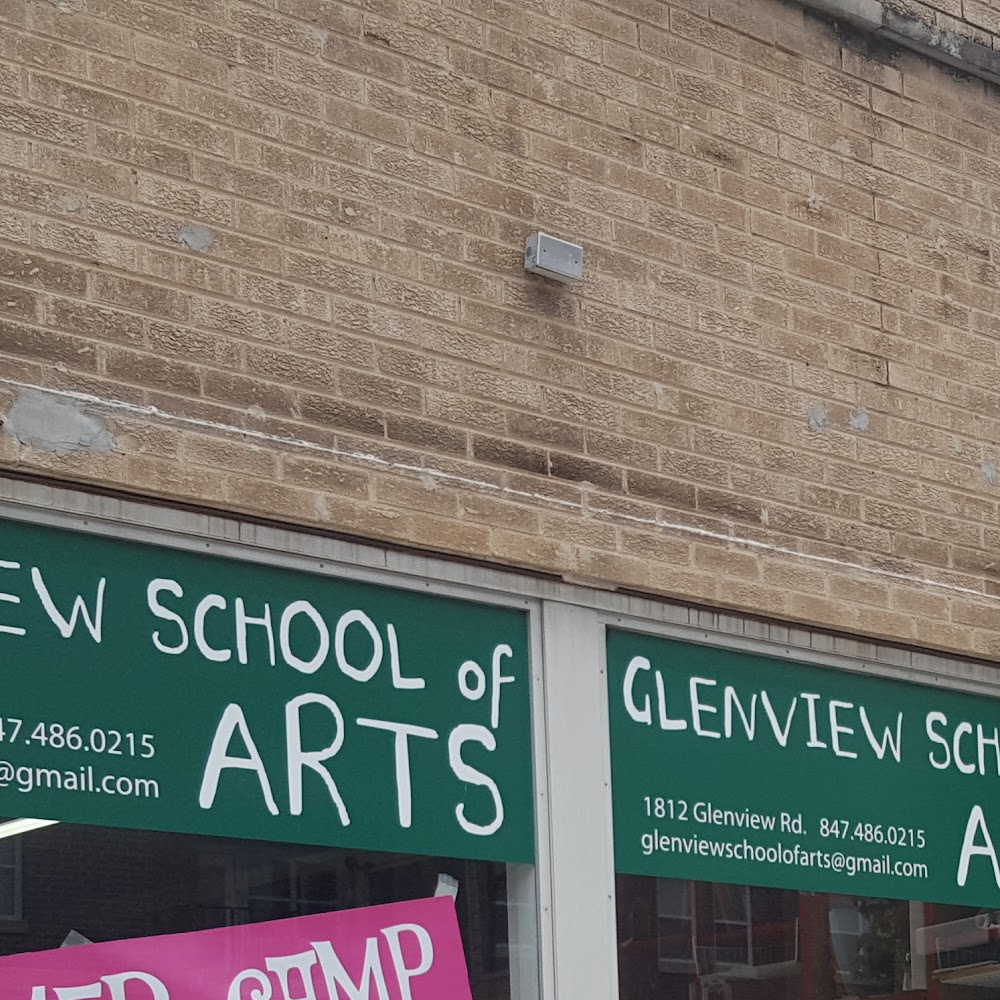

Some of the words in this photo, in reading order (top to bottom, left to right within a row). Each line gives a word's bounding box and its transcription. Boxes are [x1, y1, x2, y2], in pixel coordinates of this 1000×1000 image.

[147, 577, 426, 689] SCHOOL
[458, 644, 516, 728] of
[623, 655, 903, 763] GLENVIEW
[199, 692, 505, 836] ARTS
[641, 829, 928, 878] glenviewschoolofarts@gmail.com
[643, 796, 688, 821] 1812
[693, 802, 776, 831] Glenview
[780, 812, 807, 835] Rd.
[819, 818, 926, 848] 847.486.0215
